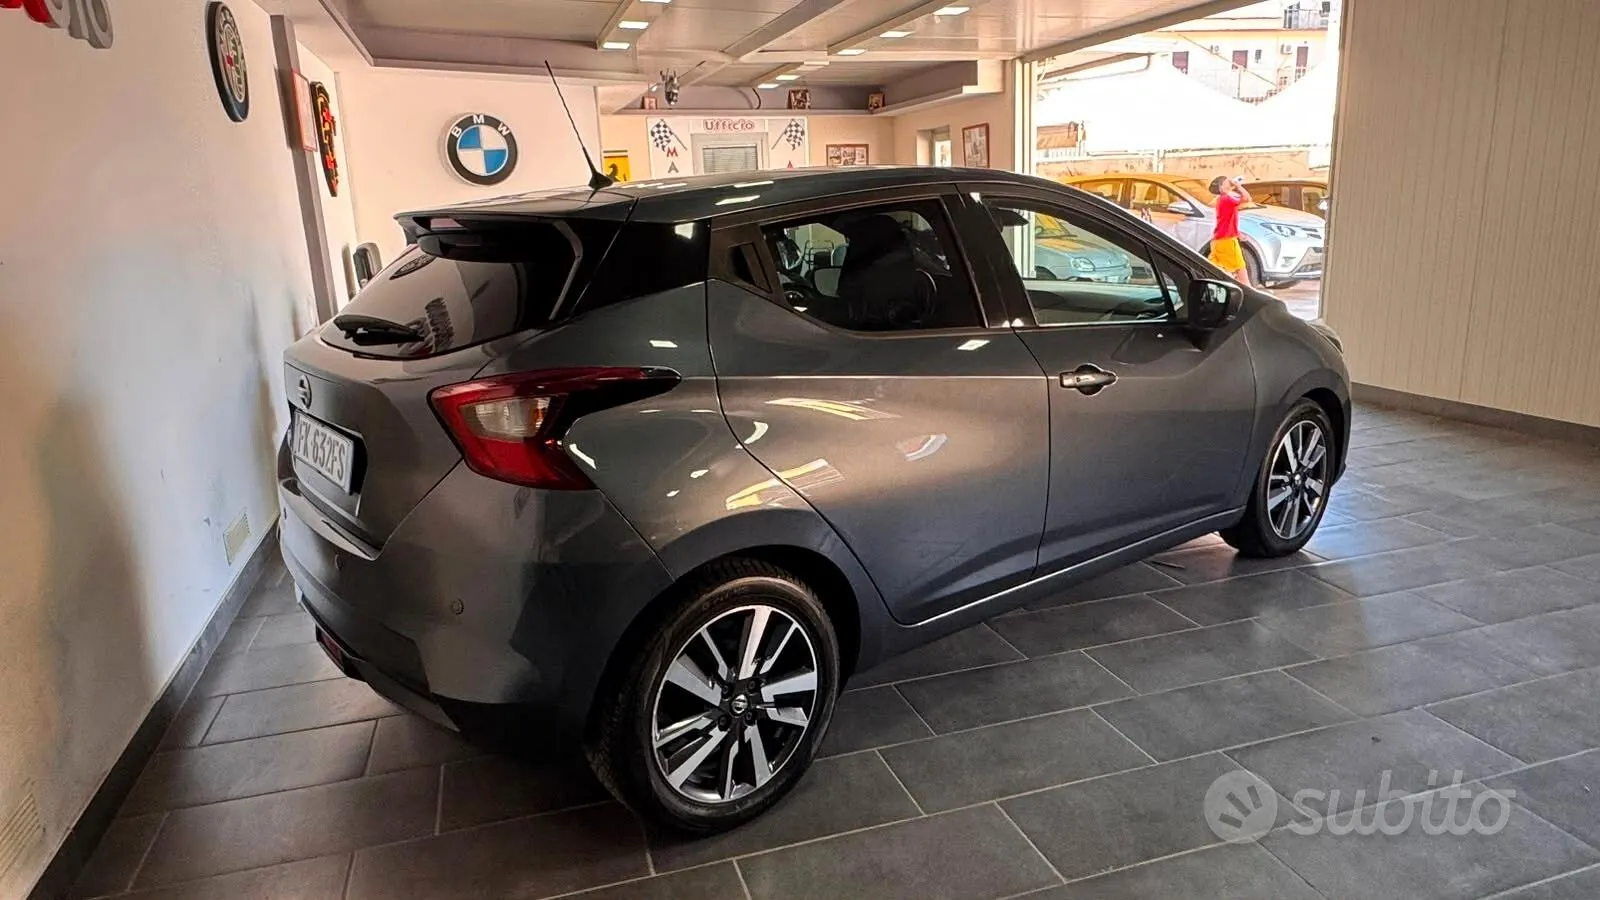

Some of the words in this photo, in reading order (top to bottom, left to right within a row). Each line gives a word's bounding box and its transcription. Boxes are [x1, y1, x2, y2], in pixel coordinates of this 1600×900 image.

[451, 114, 510, 138] BMW
[704, 118, 755, 131] Ufficio
[312, 428, 346, 481] 632FS
